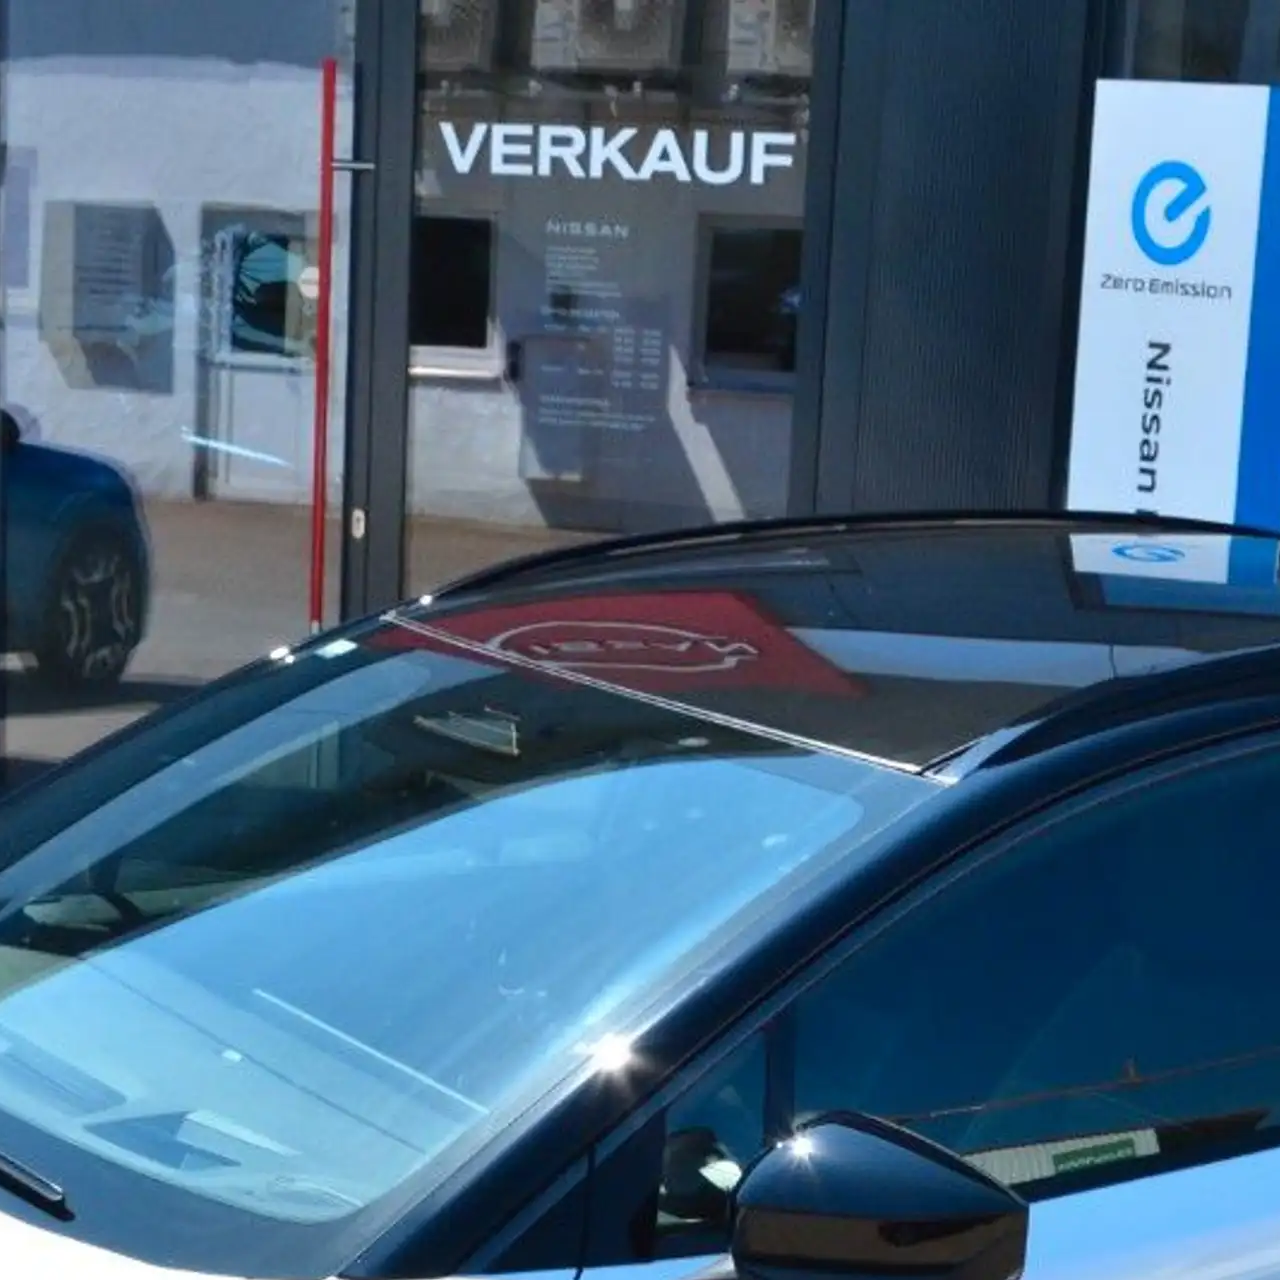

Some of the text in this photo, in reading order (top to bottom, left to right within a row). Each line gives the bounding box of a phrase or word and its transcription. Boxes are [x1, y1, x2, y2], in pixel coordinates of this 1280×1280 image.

[439, 121, 797, 185] VERKAUF
[546, 218, 629, 239] NISSAN
[1100, 273, 1232, 299] Zero Emission
[1137, 340, 1172, 493] Nissan
